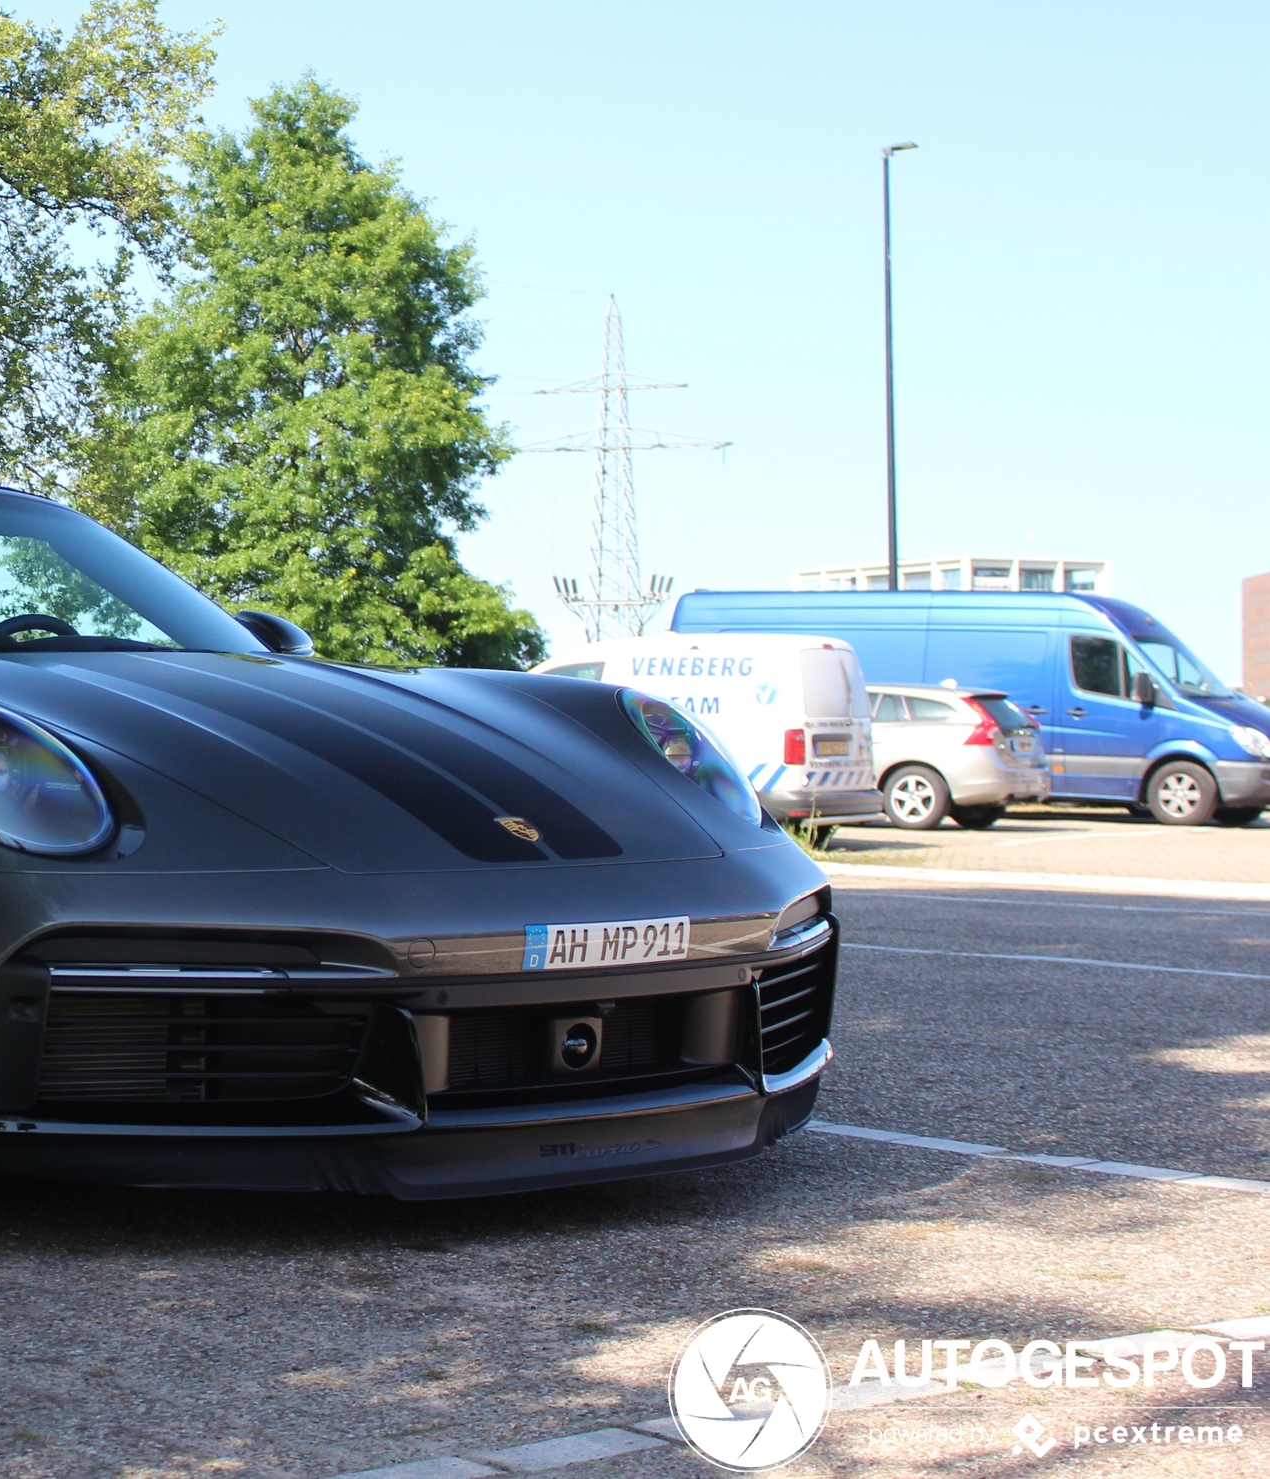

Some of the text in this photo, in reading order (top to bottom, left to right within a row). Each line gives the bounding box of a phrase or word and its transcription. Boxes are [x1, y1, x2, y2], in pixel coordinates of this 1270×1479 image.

[632, 657, 753, 676] VENEBERG
[670, 696, 720, 714] AM
[549, 928, 588, 964] AH
[530, 954, 539, 967] D
